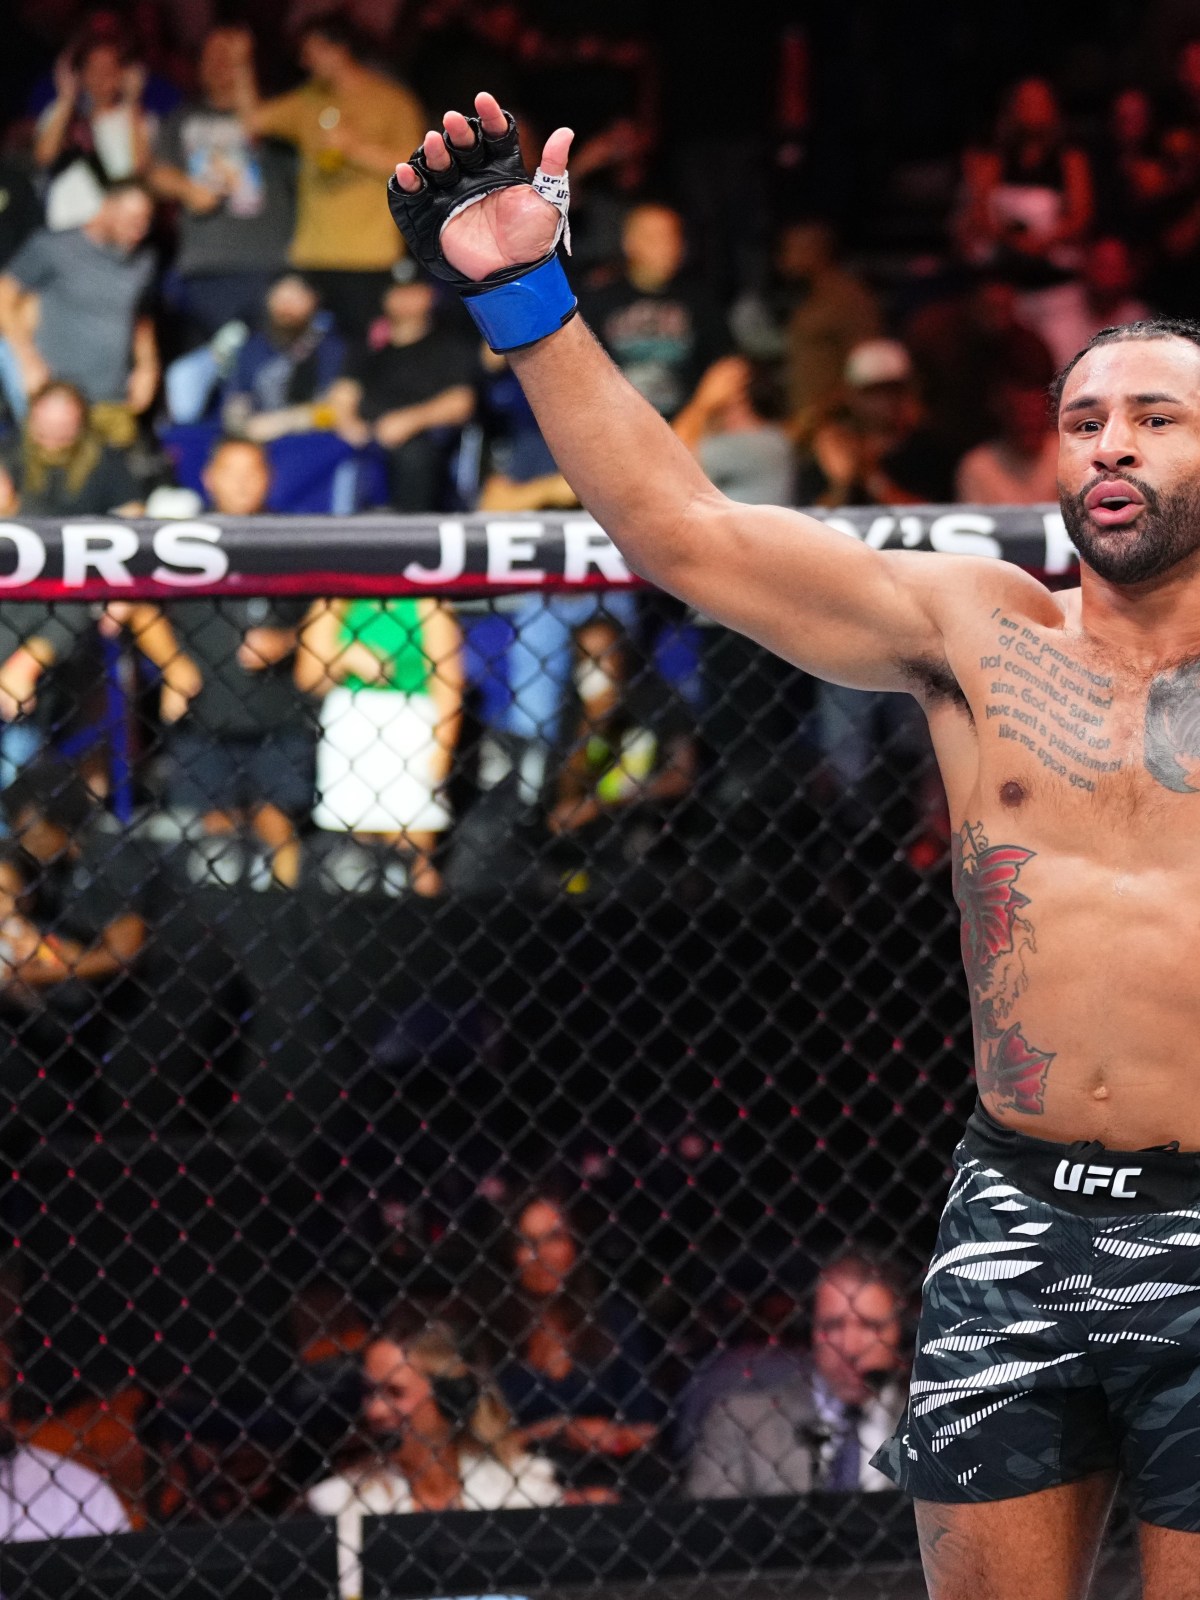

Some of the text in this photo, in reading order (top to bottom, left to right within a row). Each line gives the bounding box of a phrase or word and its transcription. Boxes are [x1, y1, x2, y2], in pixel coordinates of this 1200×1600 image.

[991, 607, 1001, 619] I
[1000, 617, 1019, 631] am
[1021, 627, 1040, 646] the
[980, 654, 1001, 670] not
[1004, 661, 1068, 706] committed
[998, 634, 1016, 651] of
[1060, 675, 1084, 697] you
[1087, 688, 1114, 710] had
[986, 704, 1011, 719] have
[1011, 708, 1038, 730] sent
[1039, 724, 1047, 737] a
[1021, 688, 1046, 713] God
[1049, 709, 1087, 740] would
[1088, 735, 1111, 750] not
[998, 723, 1096, 792] like me upon you
[1053, 1159, 1143, 1199] UFC
